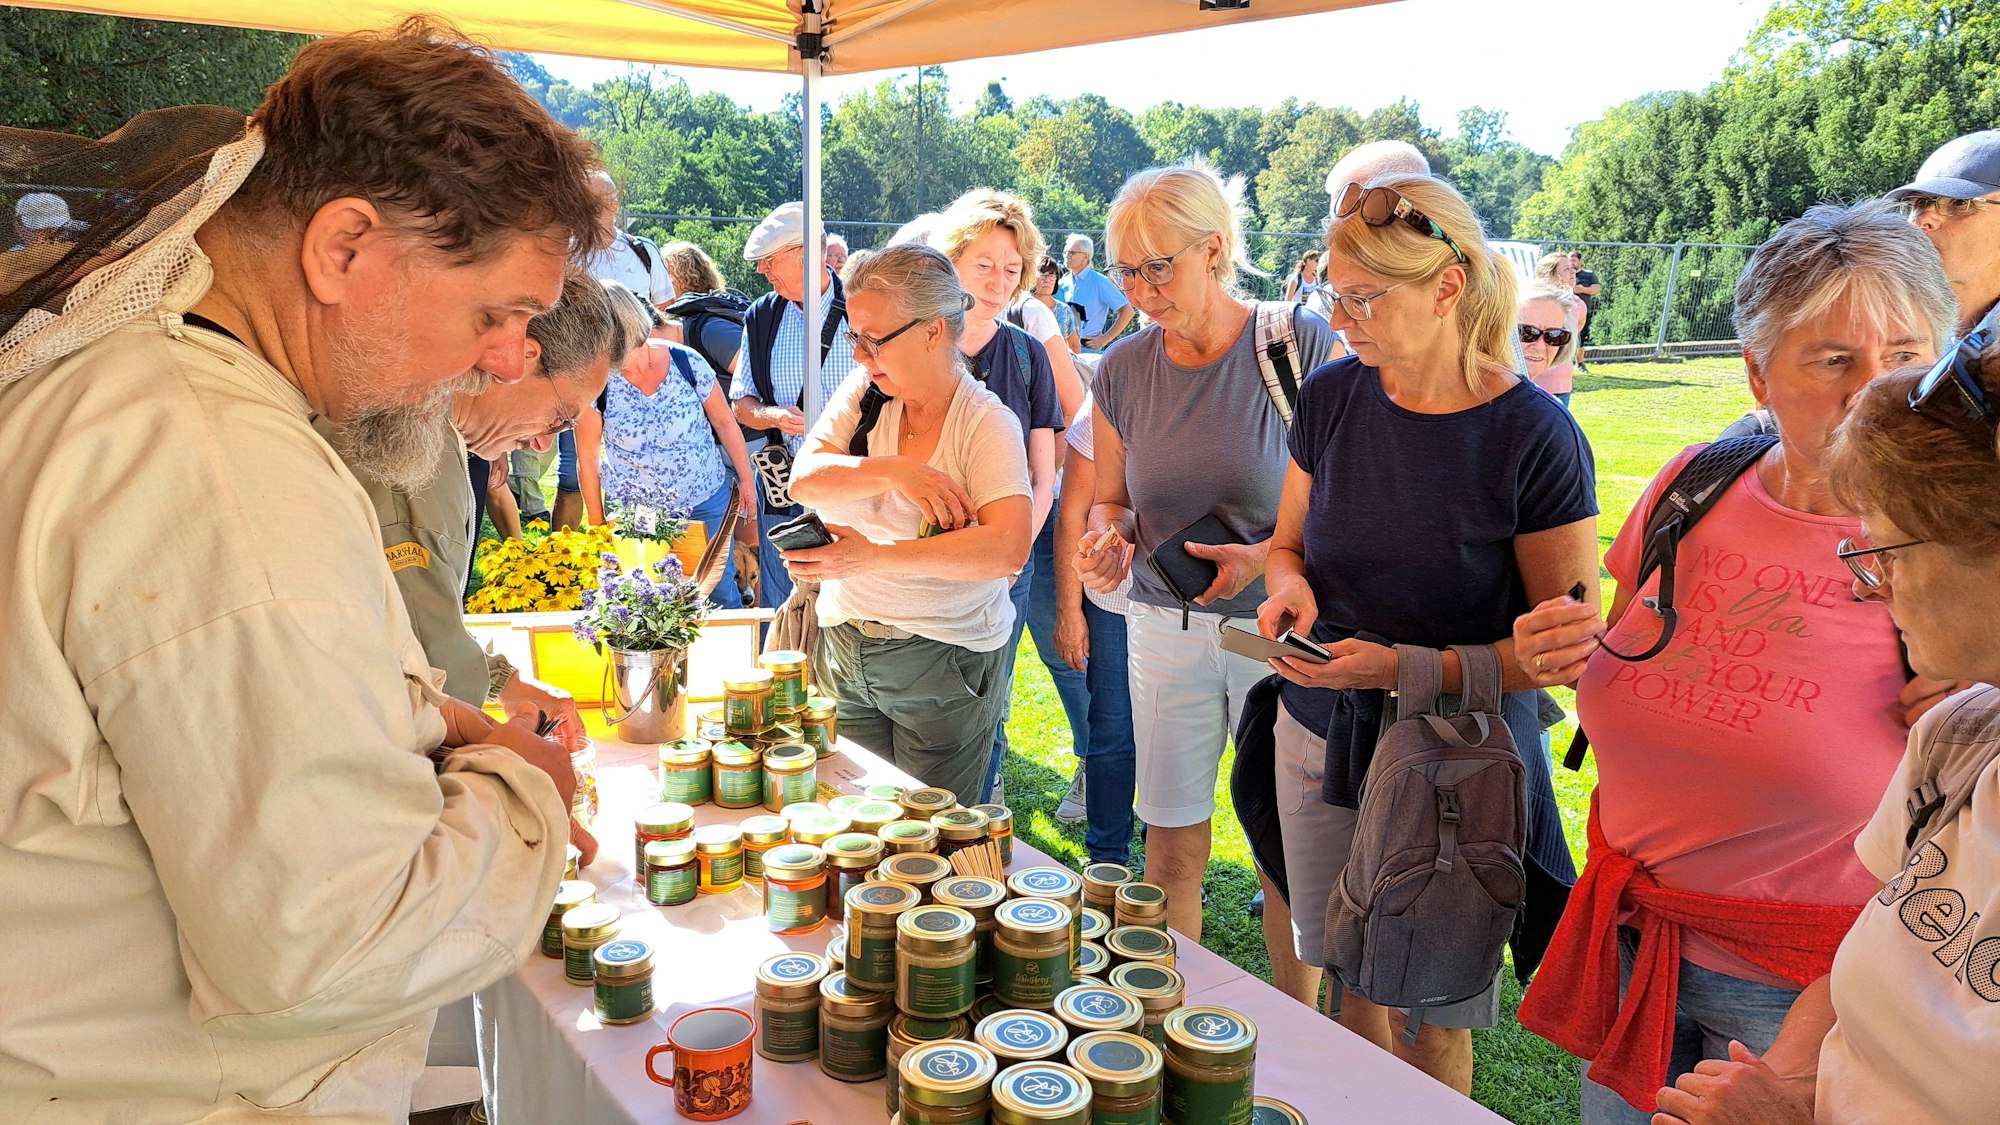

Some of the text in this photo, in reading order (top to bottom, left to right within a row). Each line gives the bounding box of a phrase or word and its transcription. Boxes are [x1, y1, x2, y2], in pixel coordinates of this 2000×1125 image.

[1689, 545, 1848, 609] NO ONE
[1674, 615, 1767, 658] AND
[1685, 581, 1813, 638] IS You
[1605, 663, 1762, 733] POWER
[1704, 654, 1821, 713] YOUR
